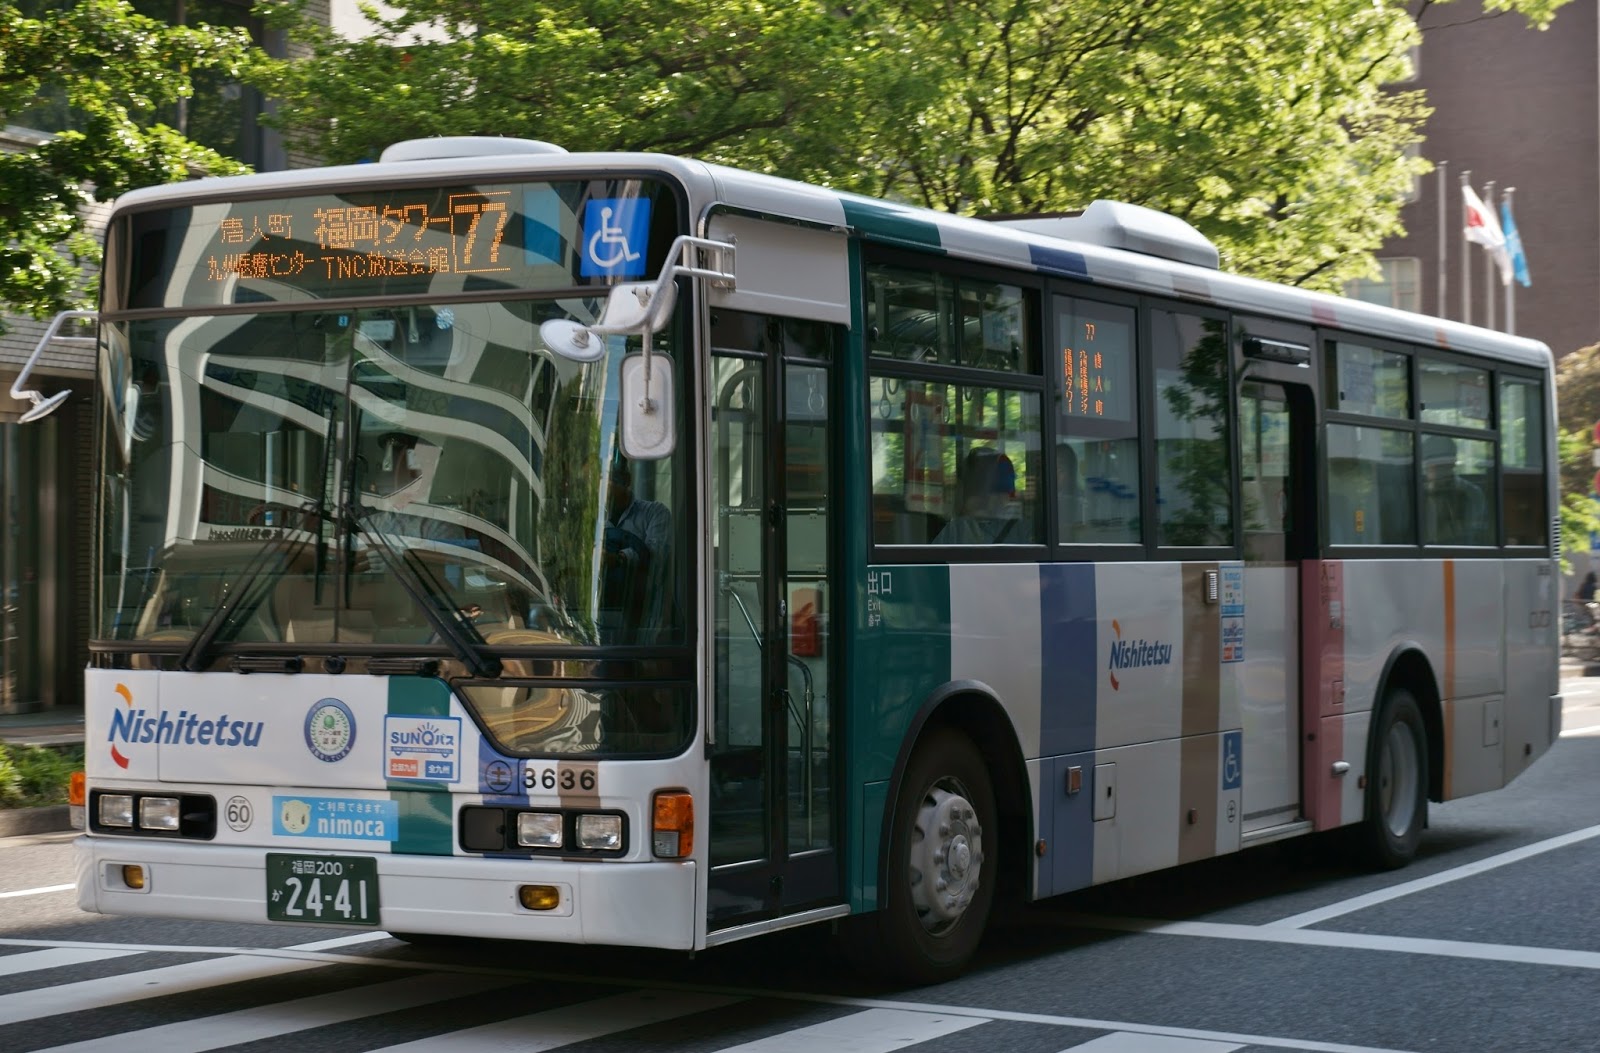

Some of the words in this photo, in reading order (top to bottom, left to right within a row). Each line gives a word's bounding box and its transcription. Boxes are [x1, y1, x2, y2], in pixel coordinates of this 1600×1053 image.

[220, 213, 293, 244] 唐人町
[313, 204, 450, 250] 福岡タワー
[454, 202, 508, 265] 77
[207, 250, 315, 281] 九州医療センター
[320, 246, 450, 280] TNC放送会館
[1085, 323, 1095, 341] 77
[867, 570, 892, 595] 出口
[1109, 639, 1173, 670] Nishitetsu
[107, 708, 264, 747] Nishitetsu
[522, 767, 596, 791] 3636
[227, 804, 250, 824] 60
[317, 813, 385, 837] nimoca
[271, 888, 284, 903] か
[285, 877, 368, 920] 24-41
